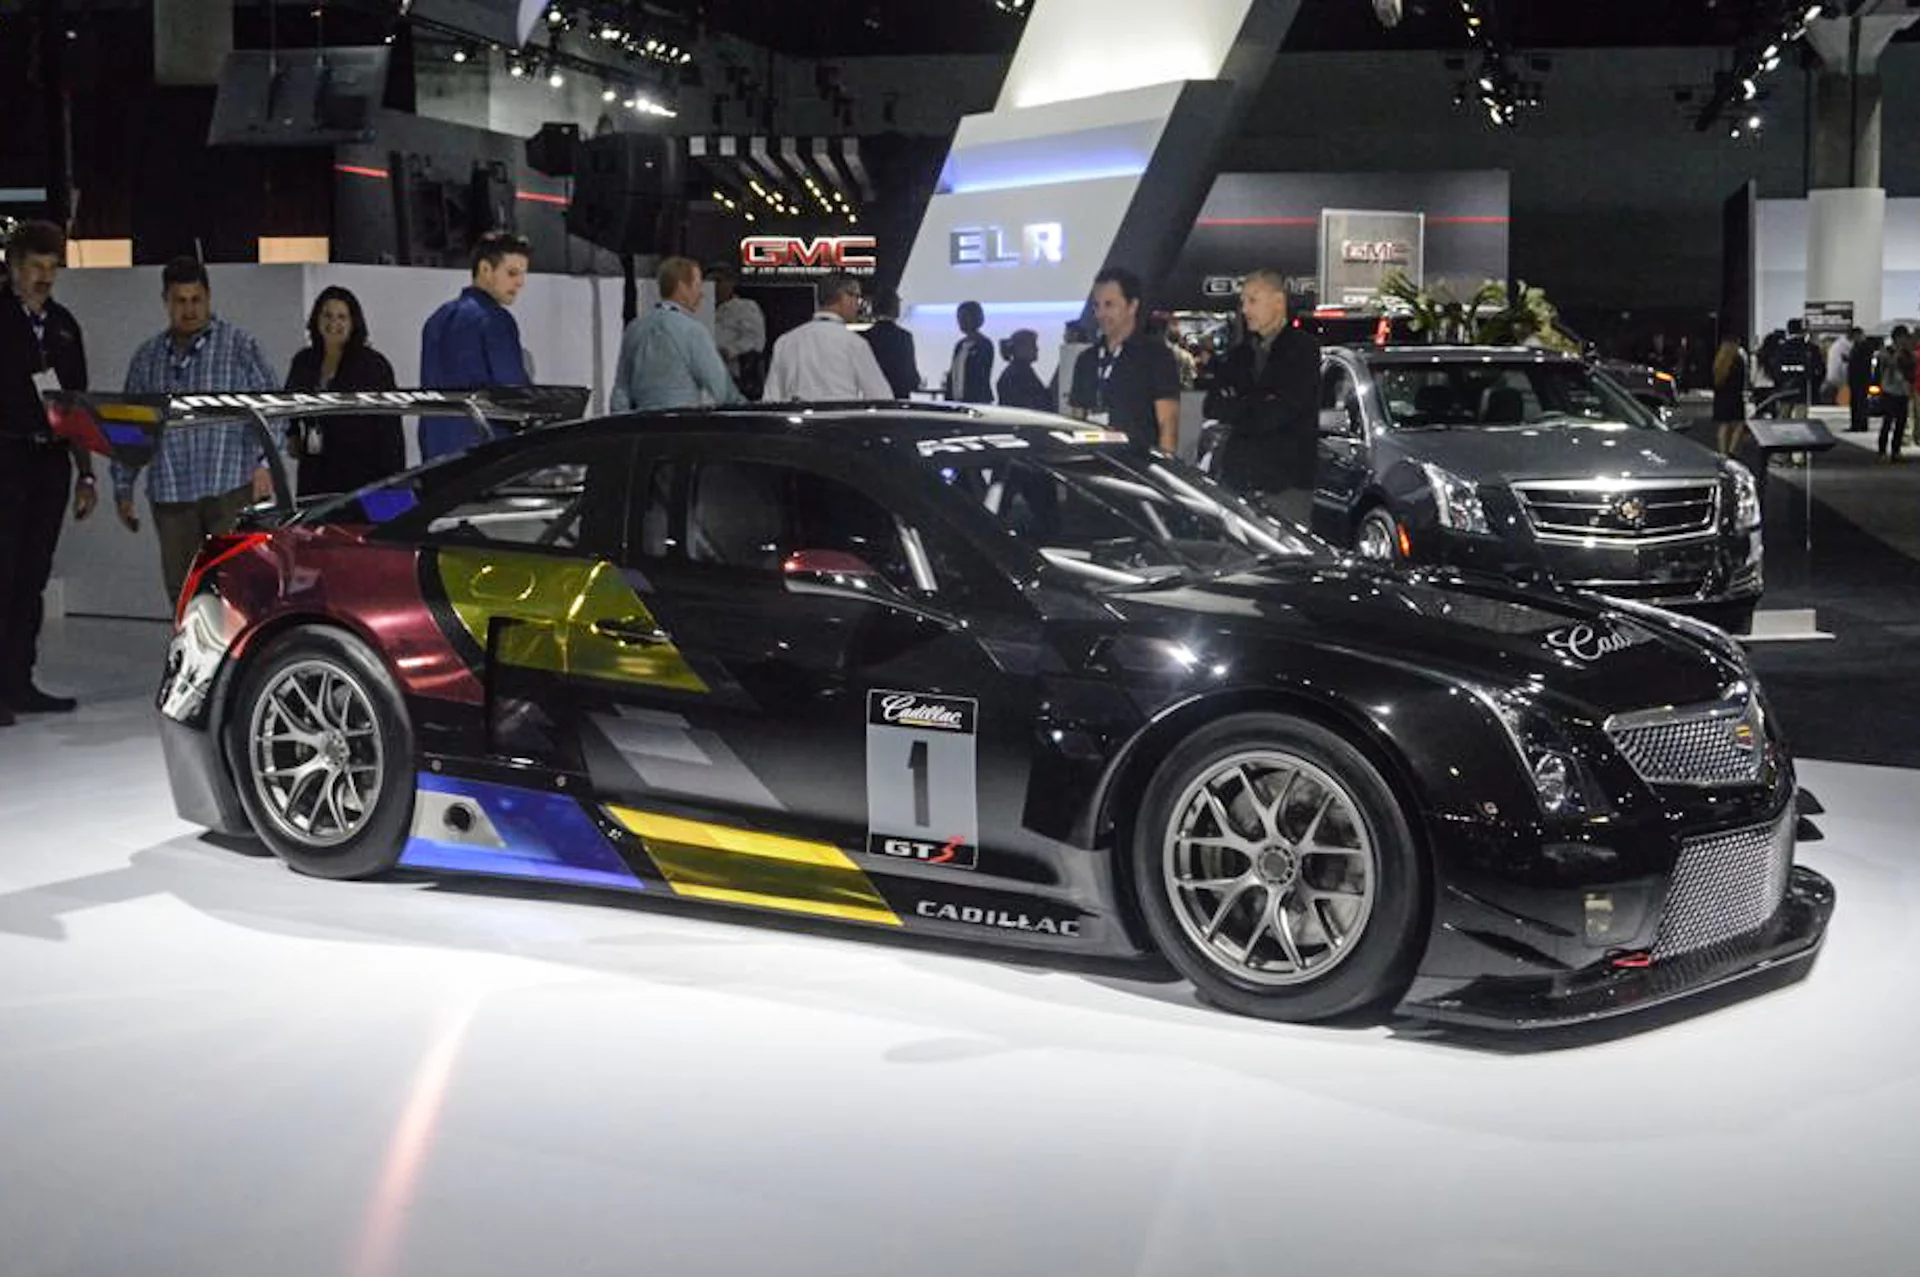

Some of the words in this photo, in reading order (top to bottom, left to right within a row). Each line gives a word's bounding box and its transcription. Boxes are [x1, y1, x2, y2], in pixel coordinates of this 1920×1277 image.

[740, 236, 877, 265] GMC
[949, 222, 1063, 267] ELR
[881, 695, 963, 724] Cadillac
[907, 740, 930, 828] 1
[916, 900, 1082, 936] CADILLAC
